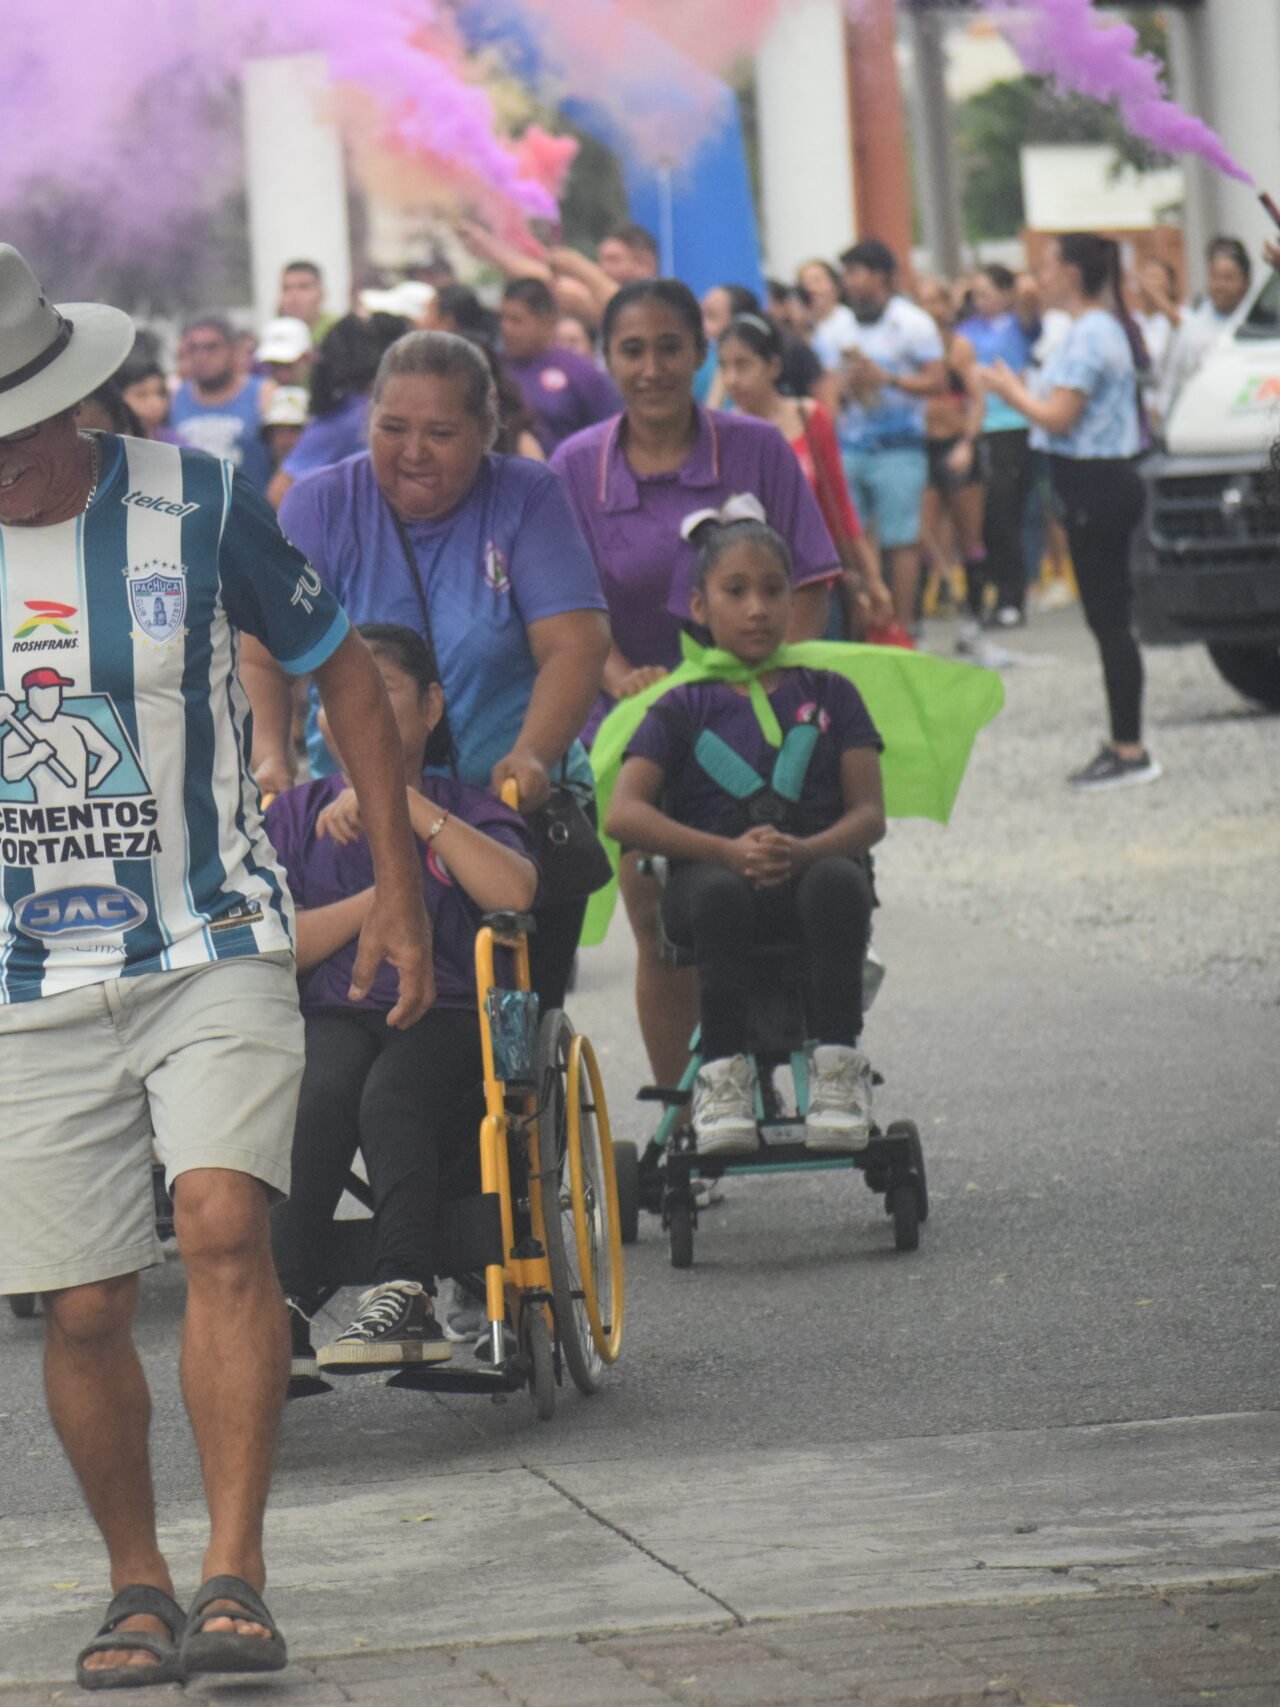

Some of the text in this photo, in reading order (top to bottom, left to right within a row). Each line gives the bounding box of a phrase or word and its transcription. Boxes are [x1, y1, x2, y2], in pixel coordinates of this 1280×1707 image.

[123, 490, 195, 516] telcel
[135, 580, 179, 592] PACHUCA
[30, 893, 127, 926] JAC
